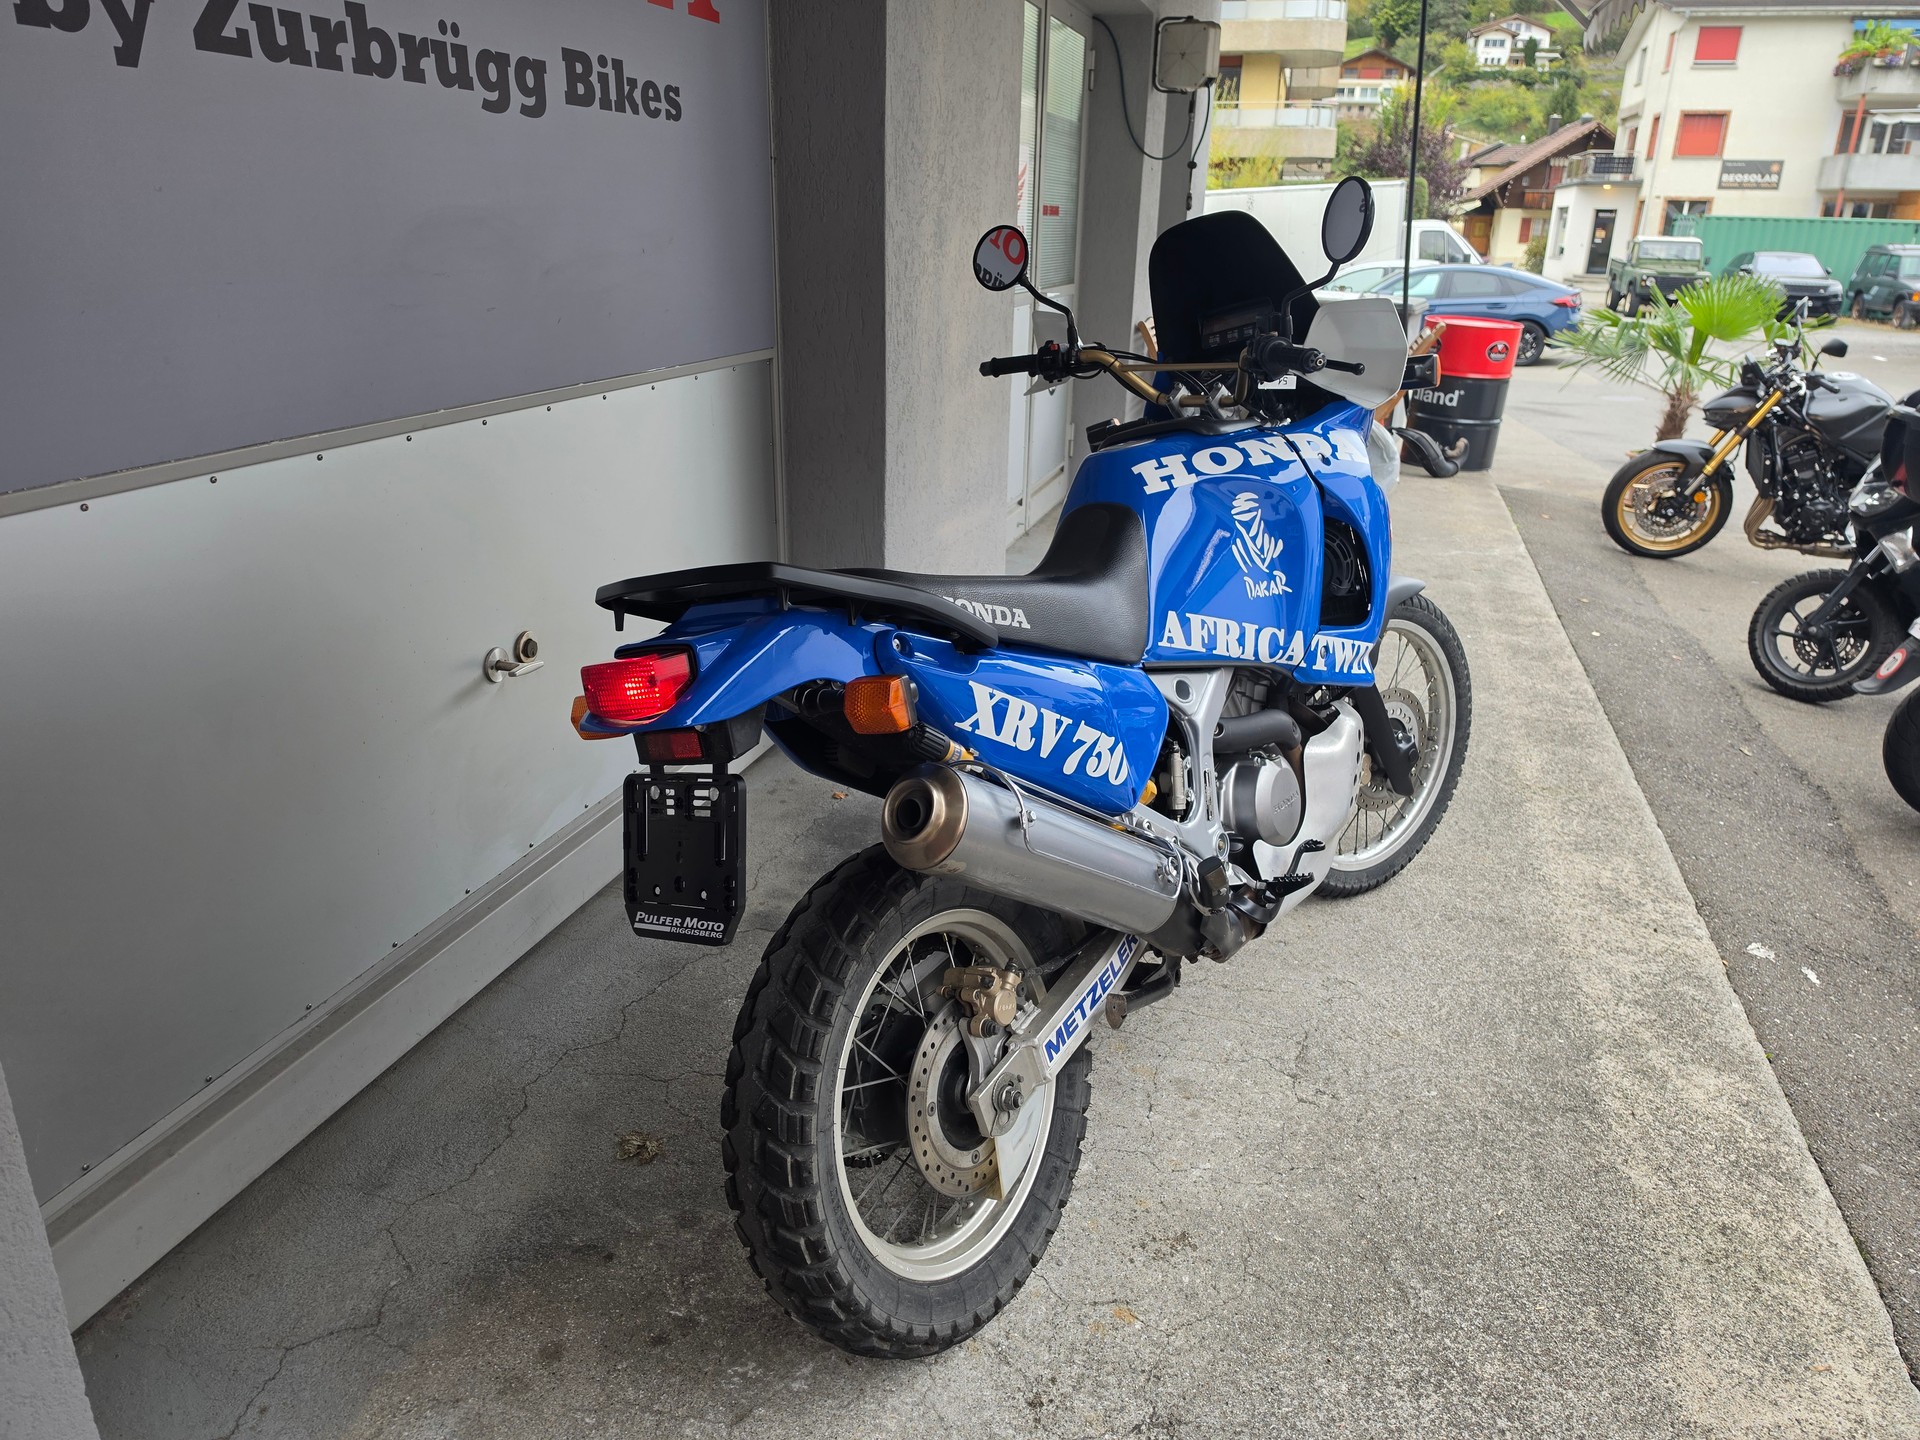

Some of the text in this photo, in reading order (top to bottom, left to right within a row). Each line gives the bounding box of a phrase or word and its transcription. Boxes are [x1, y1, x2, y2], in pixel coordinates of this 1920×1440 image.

[193, 0, 547, 119] Zurbrügg
[561, 46, 683, 122] Bikes
[1131, 428, 1370, 495] HONDA
[942, 595, 1031, 629] ONDA
[1243, 570, 1293, 600] DAKAR
[1157, 610, 1307, 668] AFRICA
[953, 680, 1128, 786] XRV 750
[635, 911, 725, 932] PULFER MOTO
[670, 926, 723, 939] RIGGISBERG
[1044, 932, 1139, 1064] METZELER
